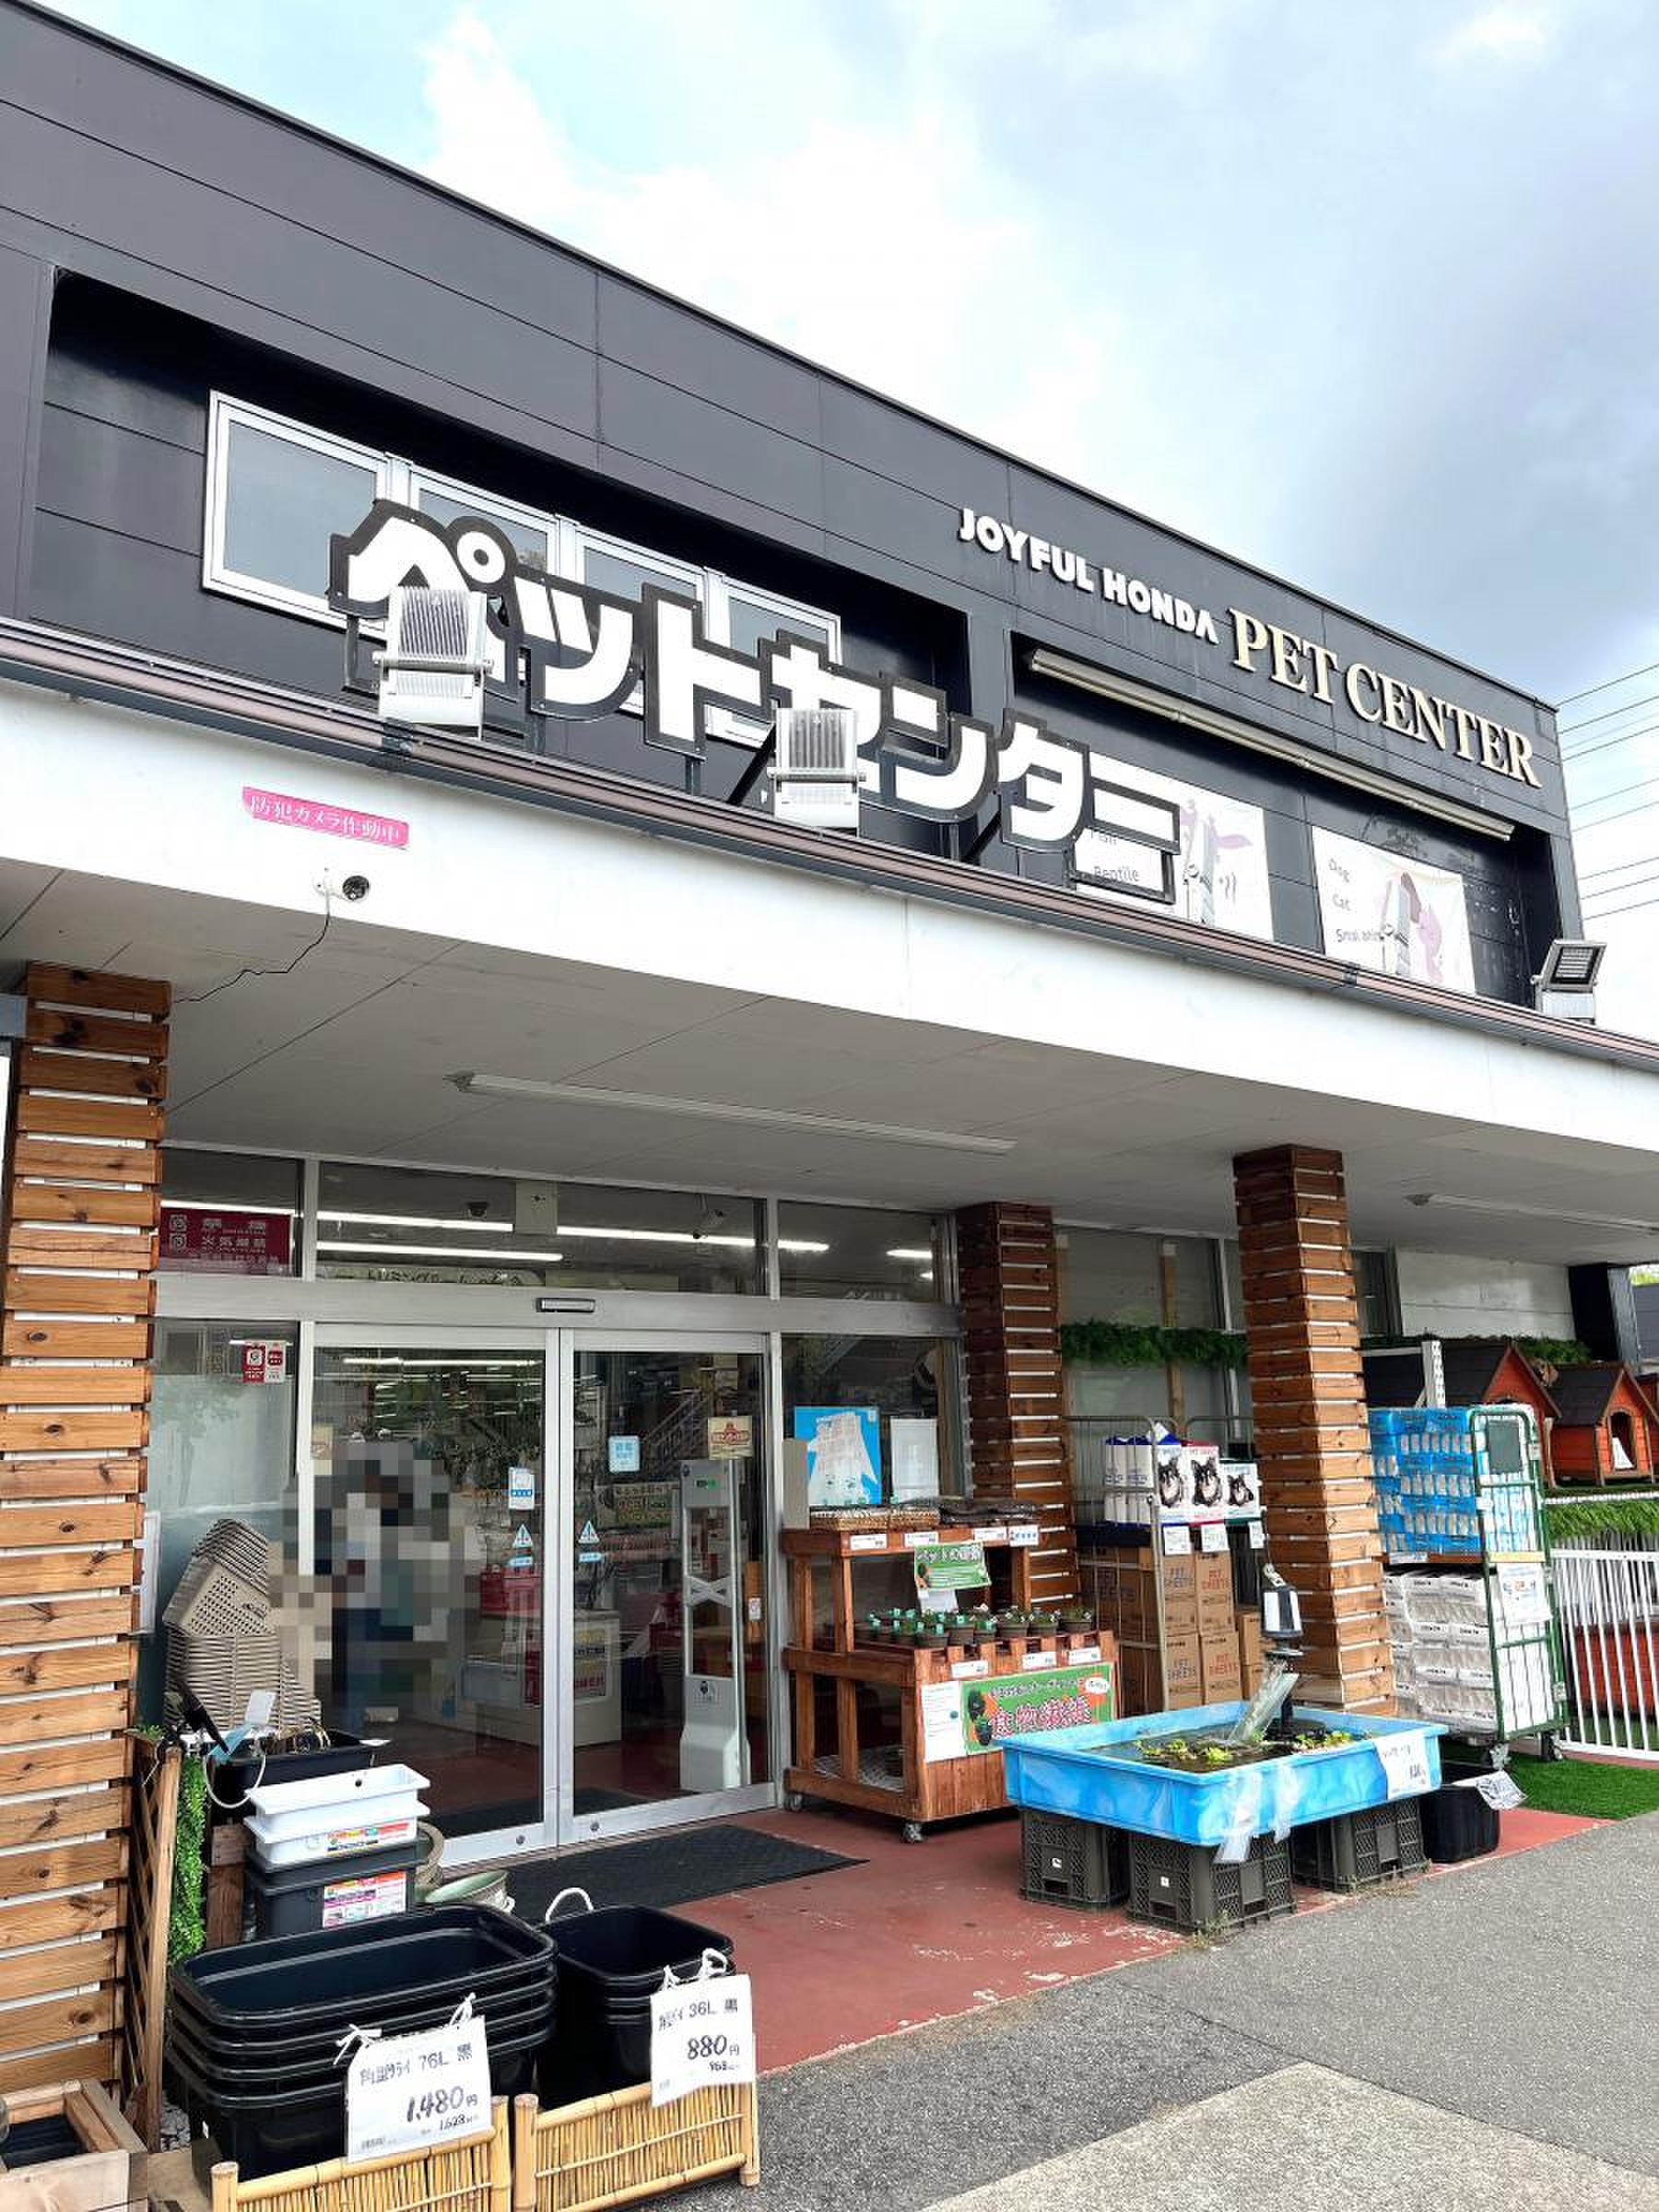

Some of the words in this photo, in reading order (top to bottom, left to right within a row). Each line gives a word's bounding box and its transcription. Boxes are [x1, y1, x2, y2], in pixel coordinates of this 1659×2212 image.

[959, 509, 1094, 594] JOYFUL
[1101, 567, 1219, 645] HONDA
[1229, 606, 1338, 705] PET
[1344, 662, 1543, 789] CENTER
[250, 794, 400, 842] 防犯カメラ作動中
[1332, 893, 1351, 912] Cat
[688, 2000, 718, 2018] 36L
[418, 2051, 450, 2071] 76L
